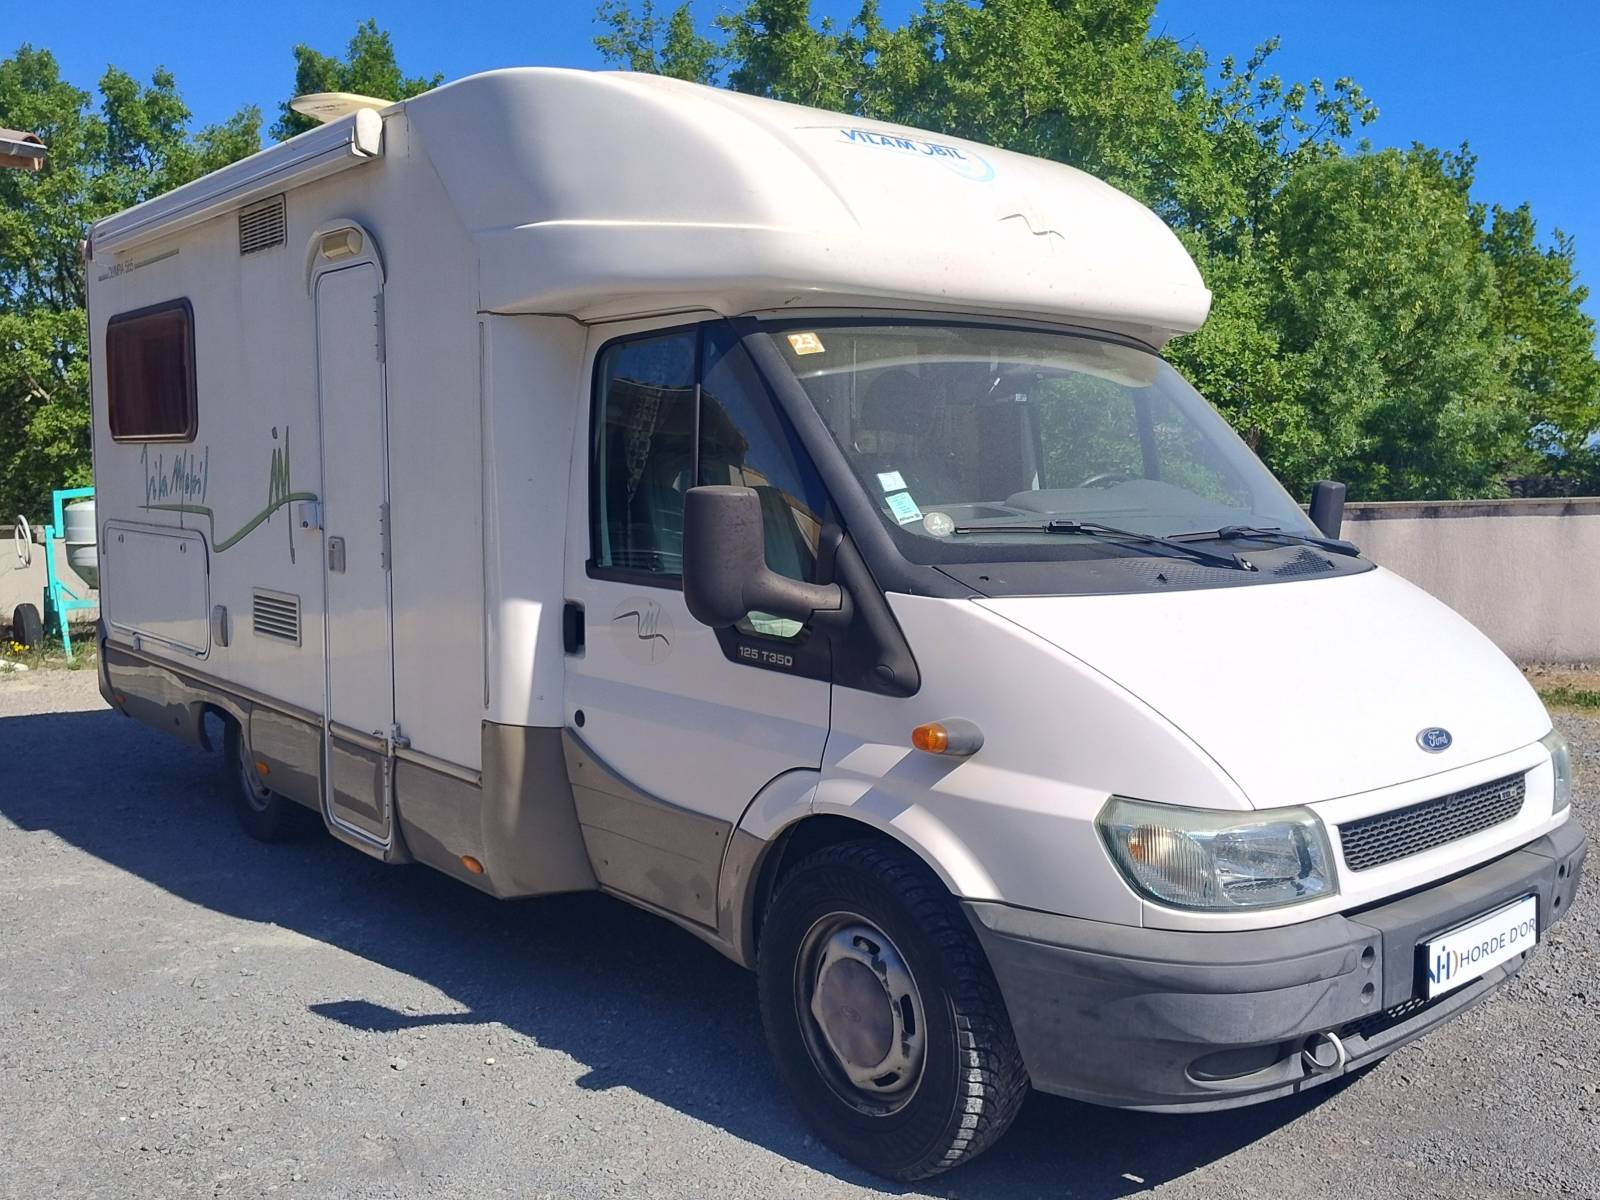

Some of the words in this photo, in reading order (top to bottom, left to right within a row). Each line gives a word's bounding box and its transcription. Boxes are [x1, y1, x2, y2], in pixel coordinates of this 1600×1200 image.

[740, 646, 759, 659] 125
[761, 650, 793, 666] T350
[1427, 730, 1448, 747] Ford
[1460, 932, 1506, 969] HORDE
[1509, 917, 1536, 944] D'OR
